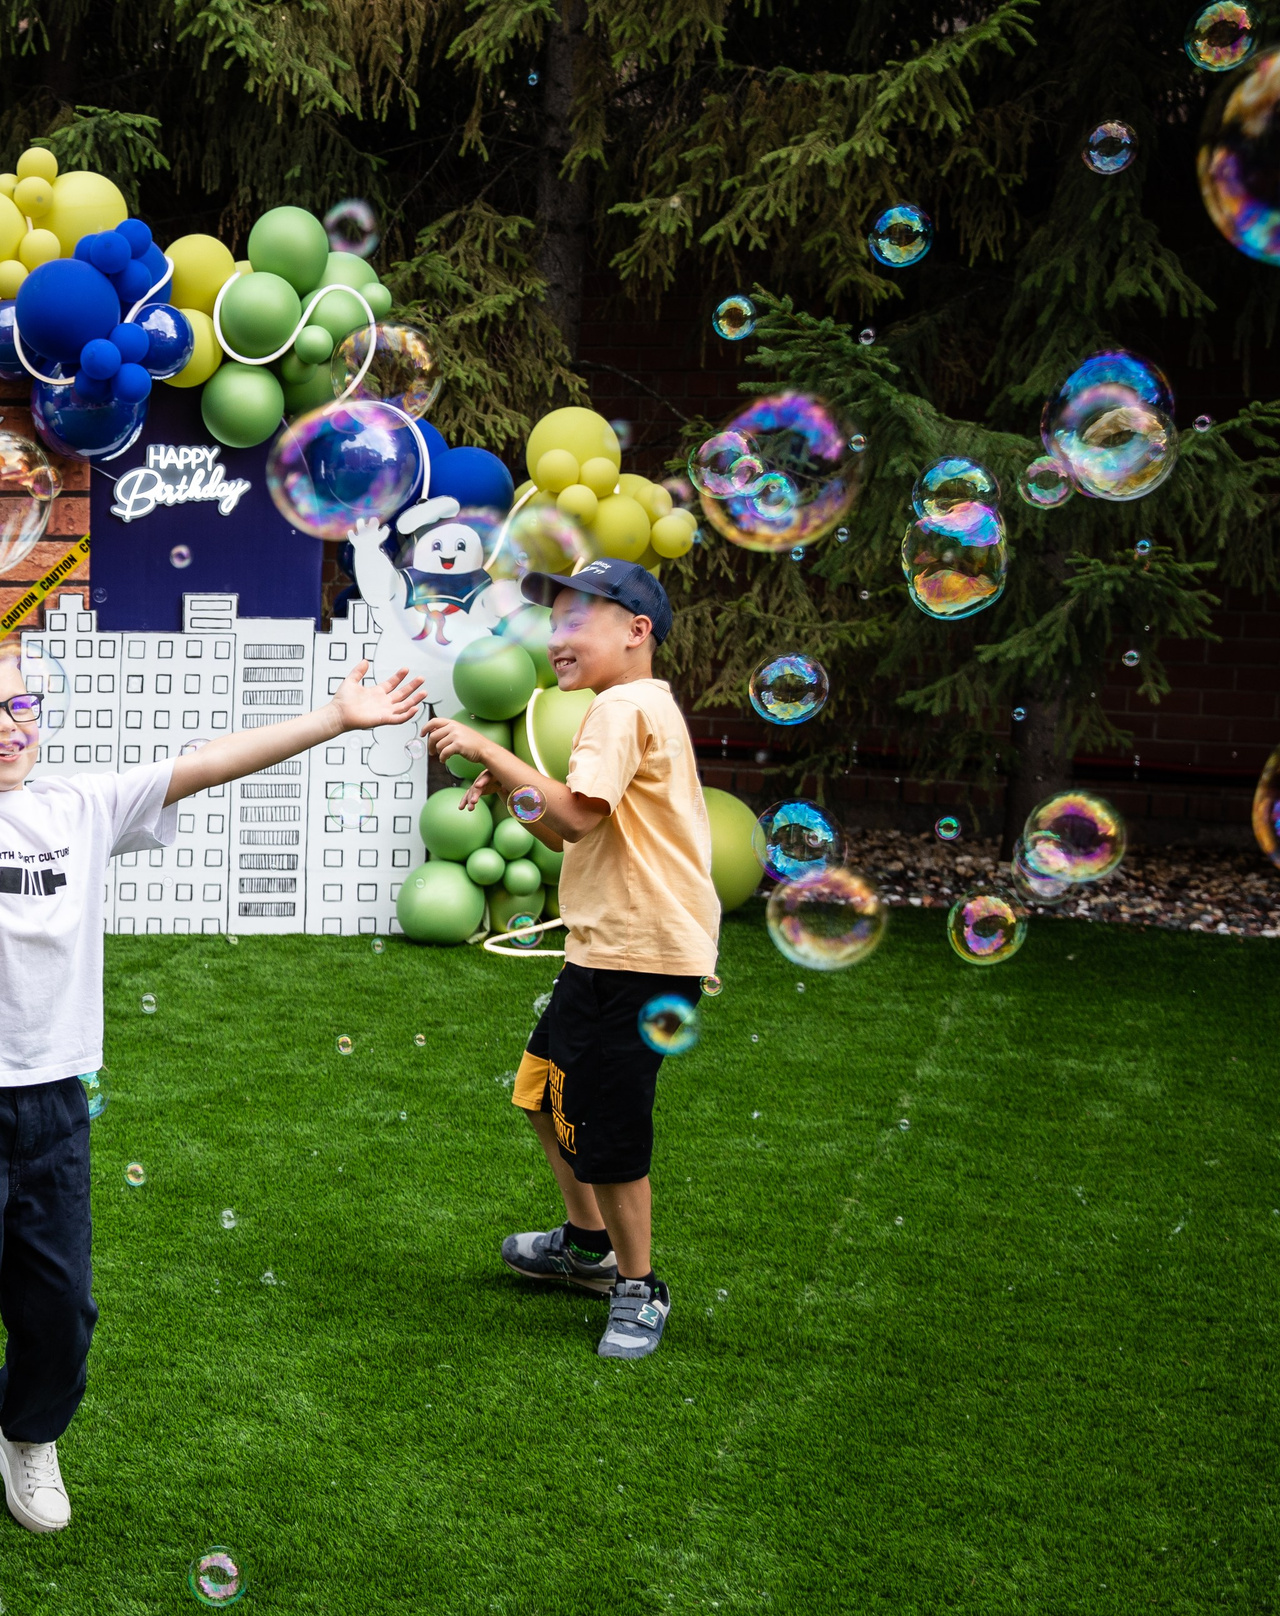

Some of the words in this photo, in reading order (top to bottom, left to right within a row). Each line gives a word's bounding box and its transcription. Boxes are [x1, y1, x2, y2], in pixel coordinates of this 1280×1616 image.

[149, 446, 219, 471] HAPPY
[112, 465, 250, 520] Birthday
[1, 592, 39, 629] CAUTION
[40, 554, 78, 591] CAUTION
